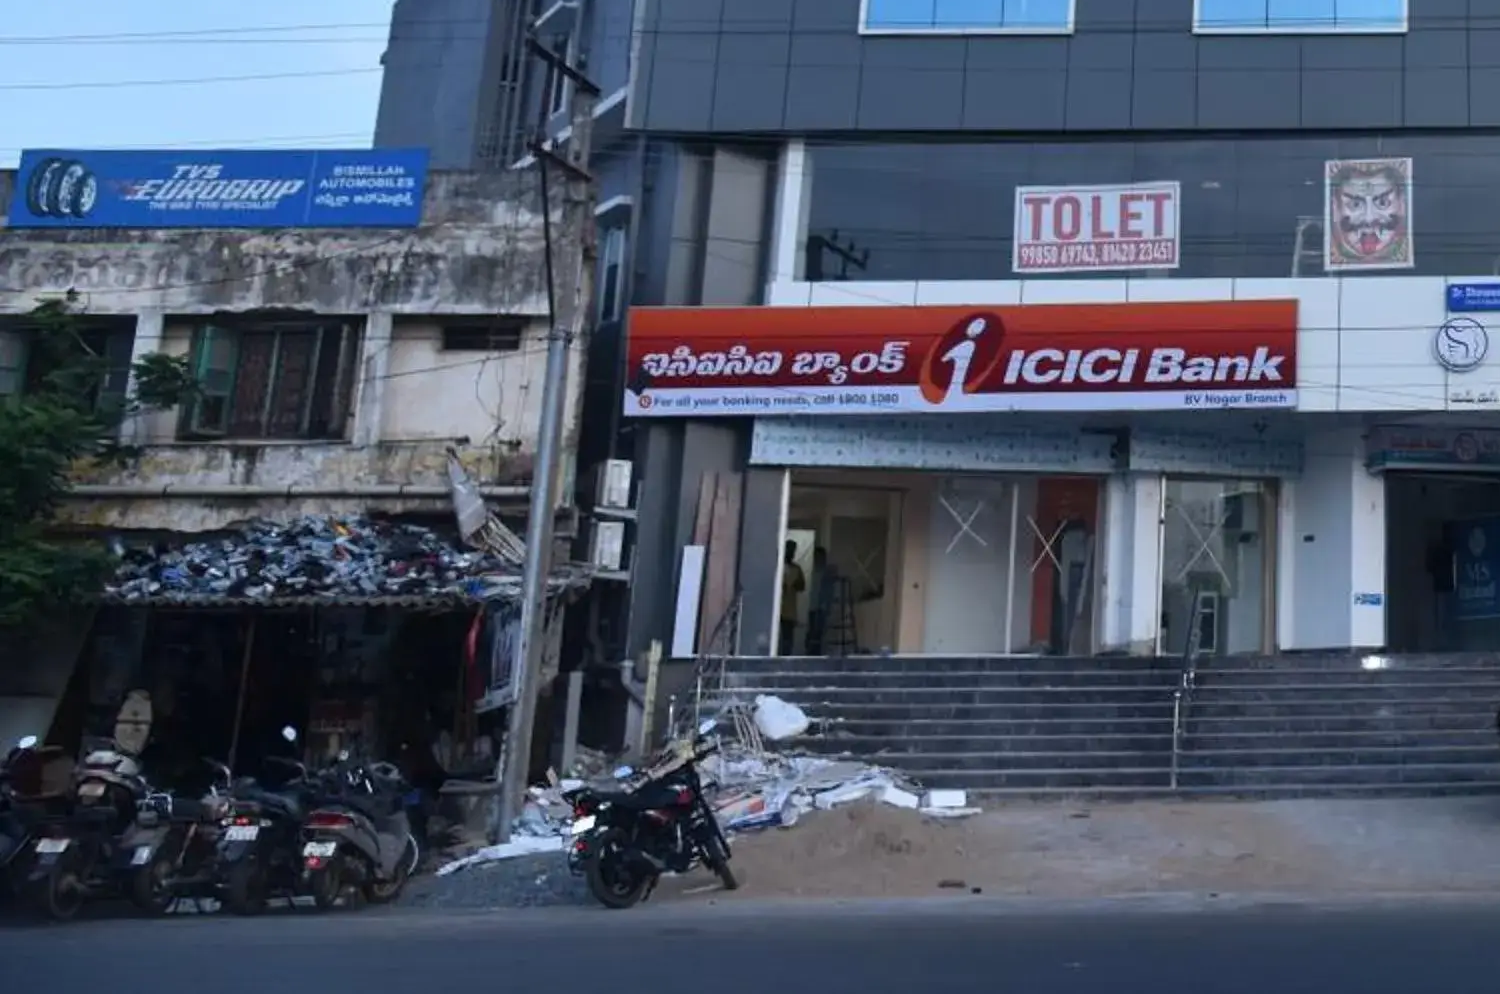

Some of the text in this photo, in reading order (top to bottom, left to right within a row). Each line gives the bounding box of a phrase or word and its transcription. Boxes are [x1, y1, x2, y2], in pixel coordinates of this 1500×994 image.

[172, 164, 224, 179] TVS
[127, 179, 305, 201] EUROGRIP
[1023, 192, 1172, 242] TO LET
[791, 340, 911, 384] బ్యాంక్
[1003, 346, 1285, 385] ICICI Bank
[722, 394, 770, 408] banking
